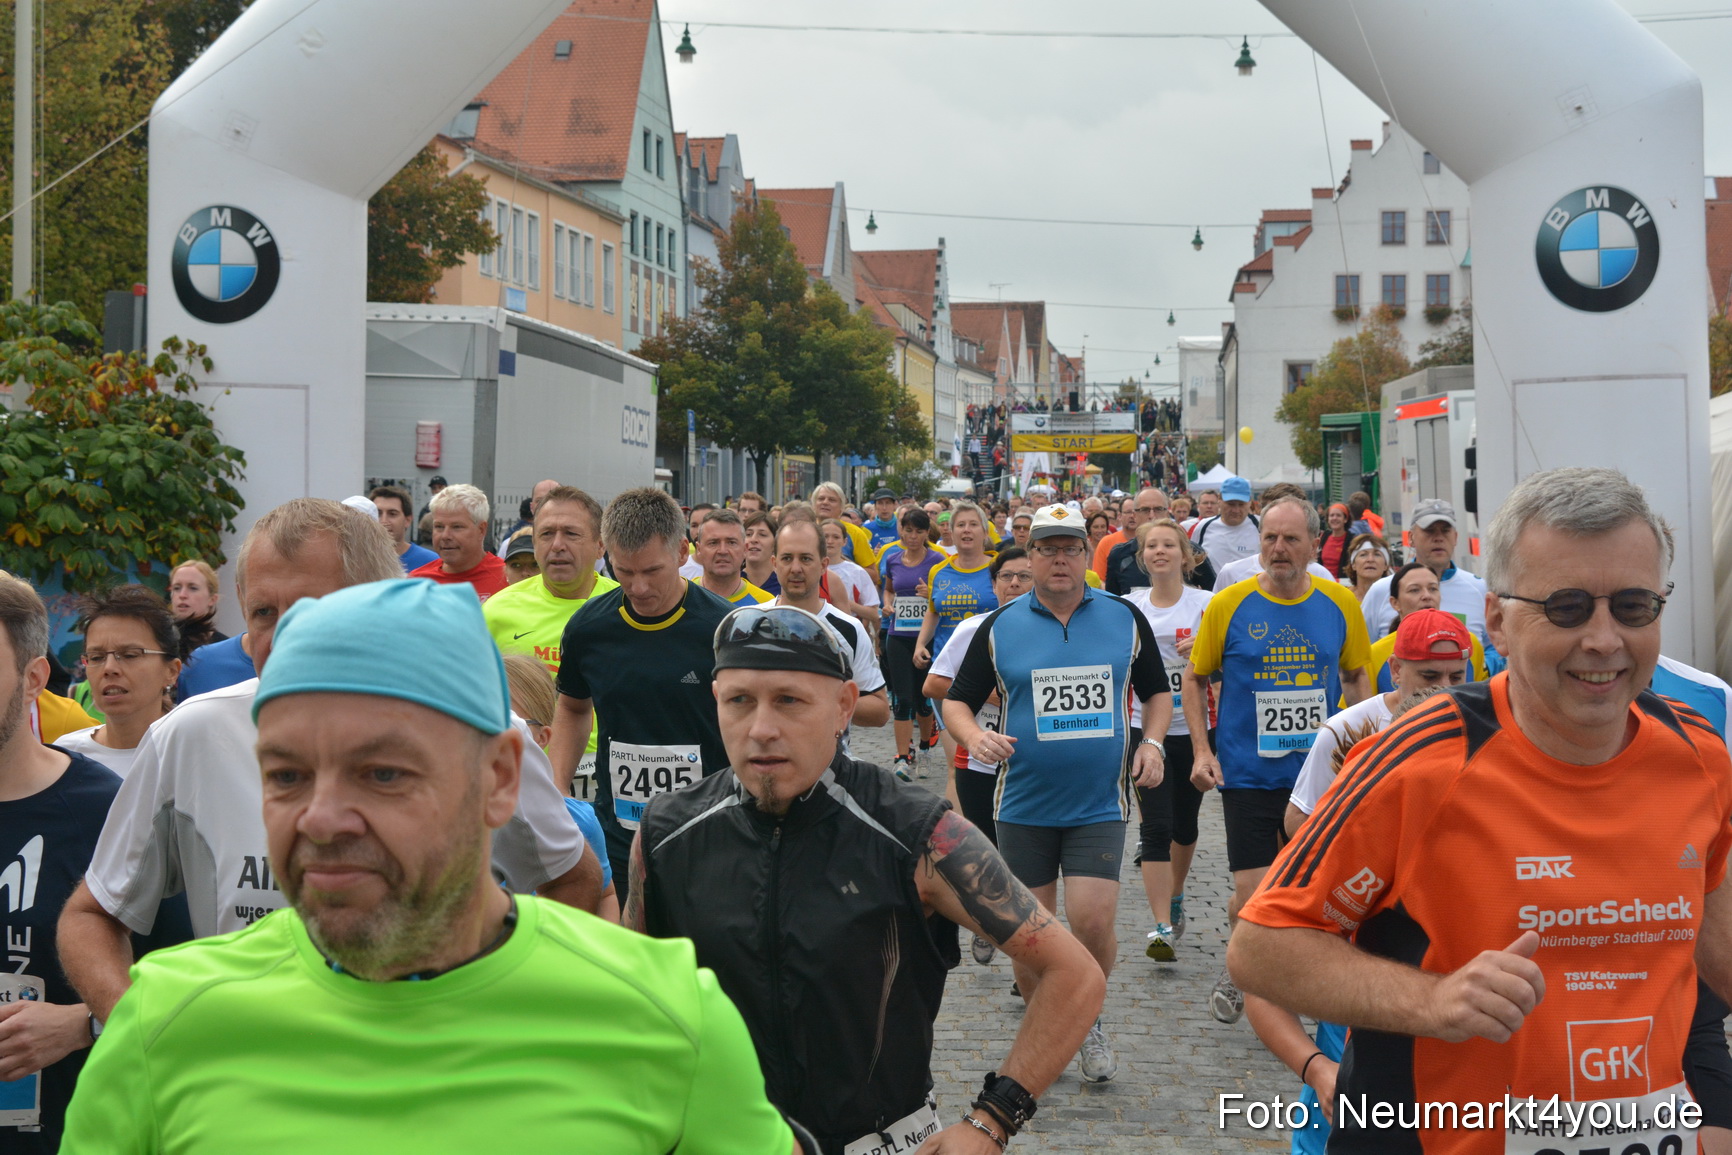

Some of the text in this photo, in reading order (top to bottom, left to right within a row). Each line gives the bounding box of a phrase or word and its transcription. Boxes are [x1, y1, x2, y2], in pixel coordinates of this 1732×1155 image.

[1544, 188, 1651, 232] BMW
[179, 207, 272, 247] BMW
[1052, 437, 1096, 449] START
[898, 605, 928, 618] 2588
[1034, 673, 1099, 683] PARTL Neumarkt
[1042, 683, 1107, 712] 2533
[1283, 696, 1316, 704] Neumarkt
[981, 711, 1000, 719] PART
[1264, 706, 1321, 732] 2535
[1053, 717, 1099, 730] Bernhard
[1278, 737, 1309, 748] Hubert
[611, 750, 684, 763] PARTL Neumarkt
[618, 765, 693, 798] 2495
[1515, 856, 1576, 880] DAK
[1518, 895, 1693, 933] SportScheck
[1541, 928, 1695, 948] Nürnberger Stadtlauf 2009
[1564, 971, 1648, 981] TSV Katzwang
[1565, 981, 1617, 991] 1905 e.V.
[1579, 1045, 1644, 1082] GfK
